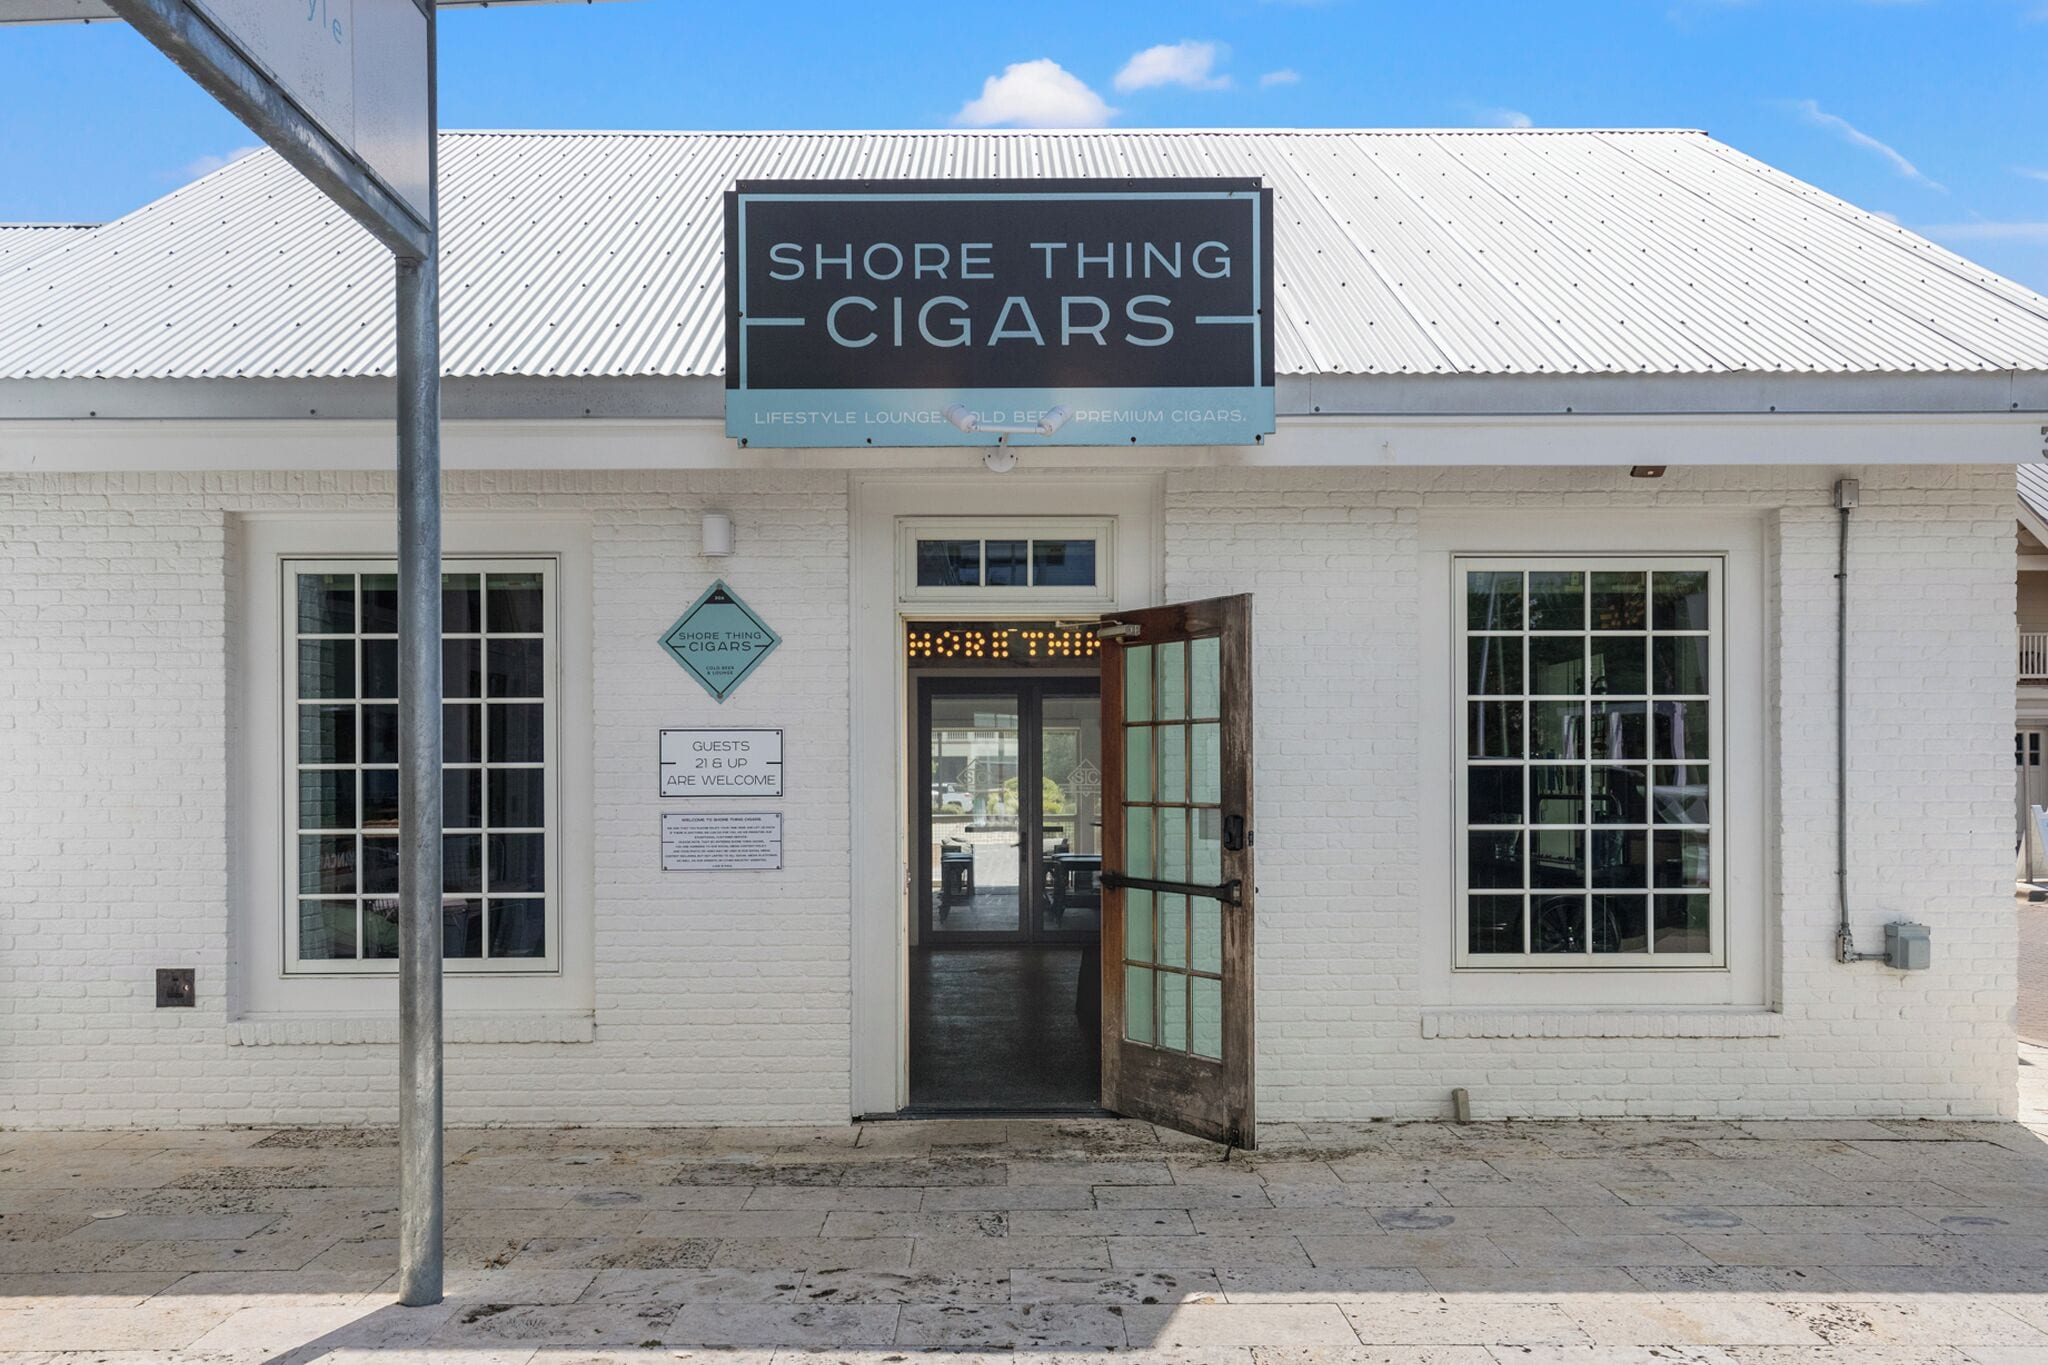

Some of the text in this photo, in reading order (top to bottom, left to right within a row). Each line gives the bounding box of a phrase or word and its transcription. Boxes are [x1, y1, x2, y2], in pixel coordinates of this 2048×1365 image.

[769, 241, 1230, 280] SHORE THING
[826, 294, 1174, 347] CIGARS
[755, 409, 1246, 424] LIFESTYLE LOUNGE. OLD BEE PREMIUM CIGARS.
[678, 631, 762, 641] SHORE THING
[688, 641, 752, 653] CIGARS
[692, 740, 751, 752] GUESTS
[695, 757, 748, 769] 21 & UP
[667, 774, 777, 786] ARE WELCOME
